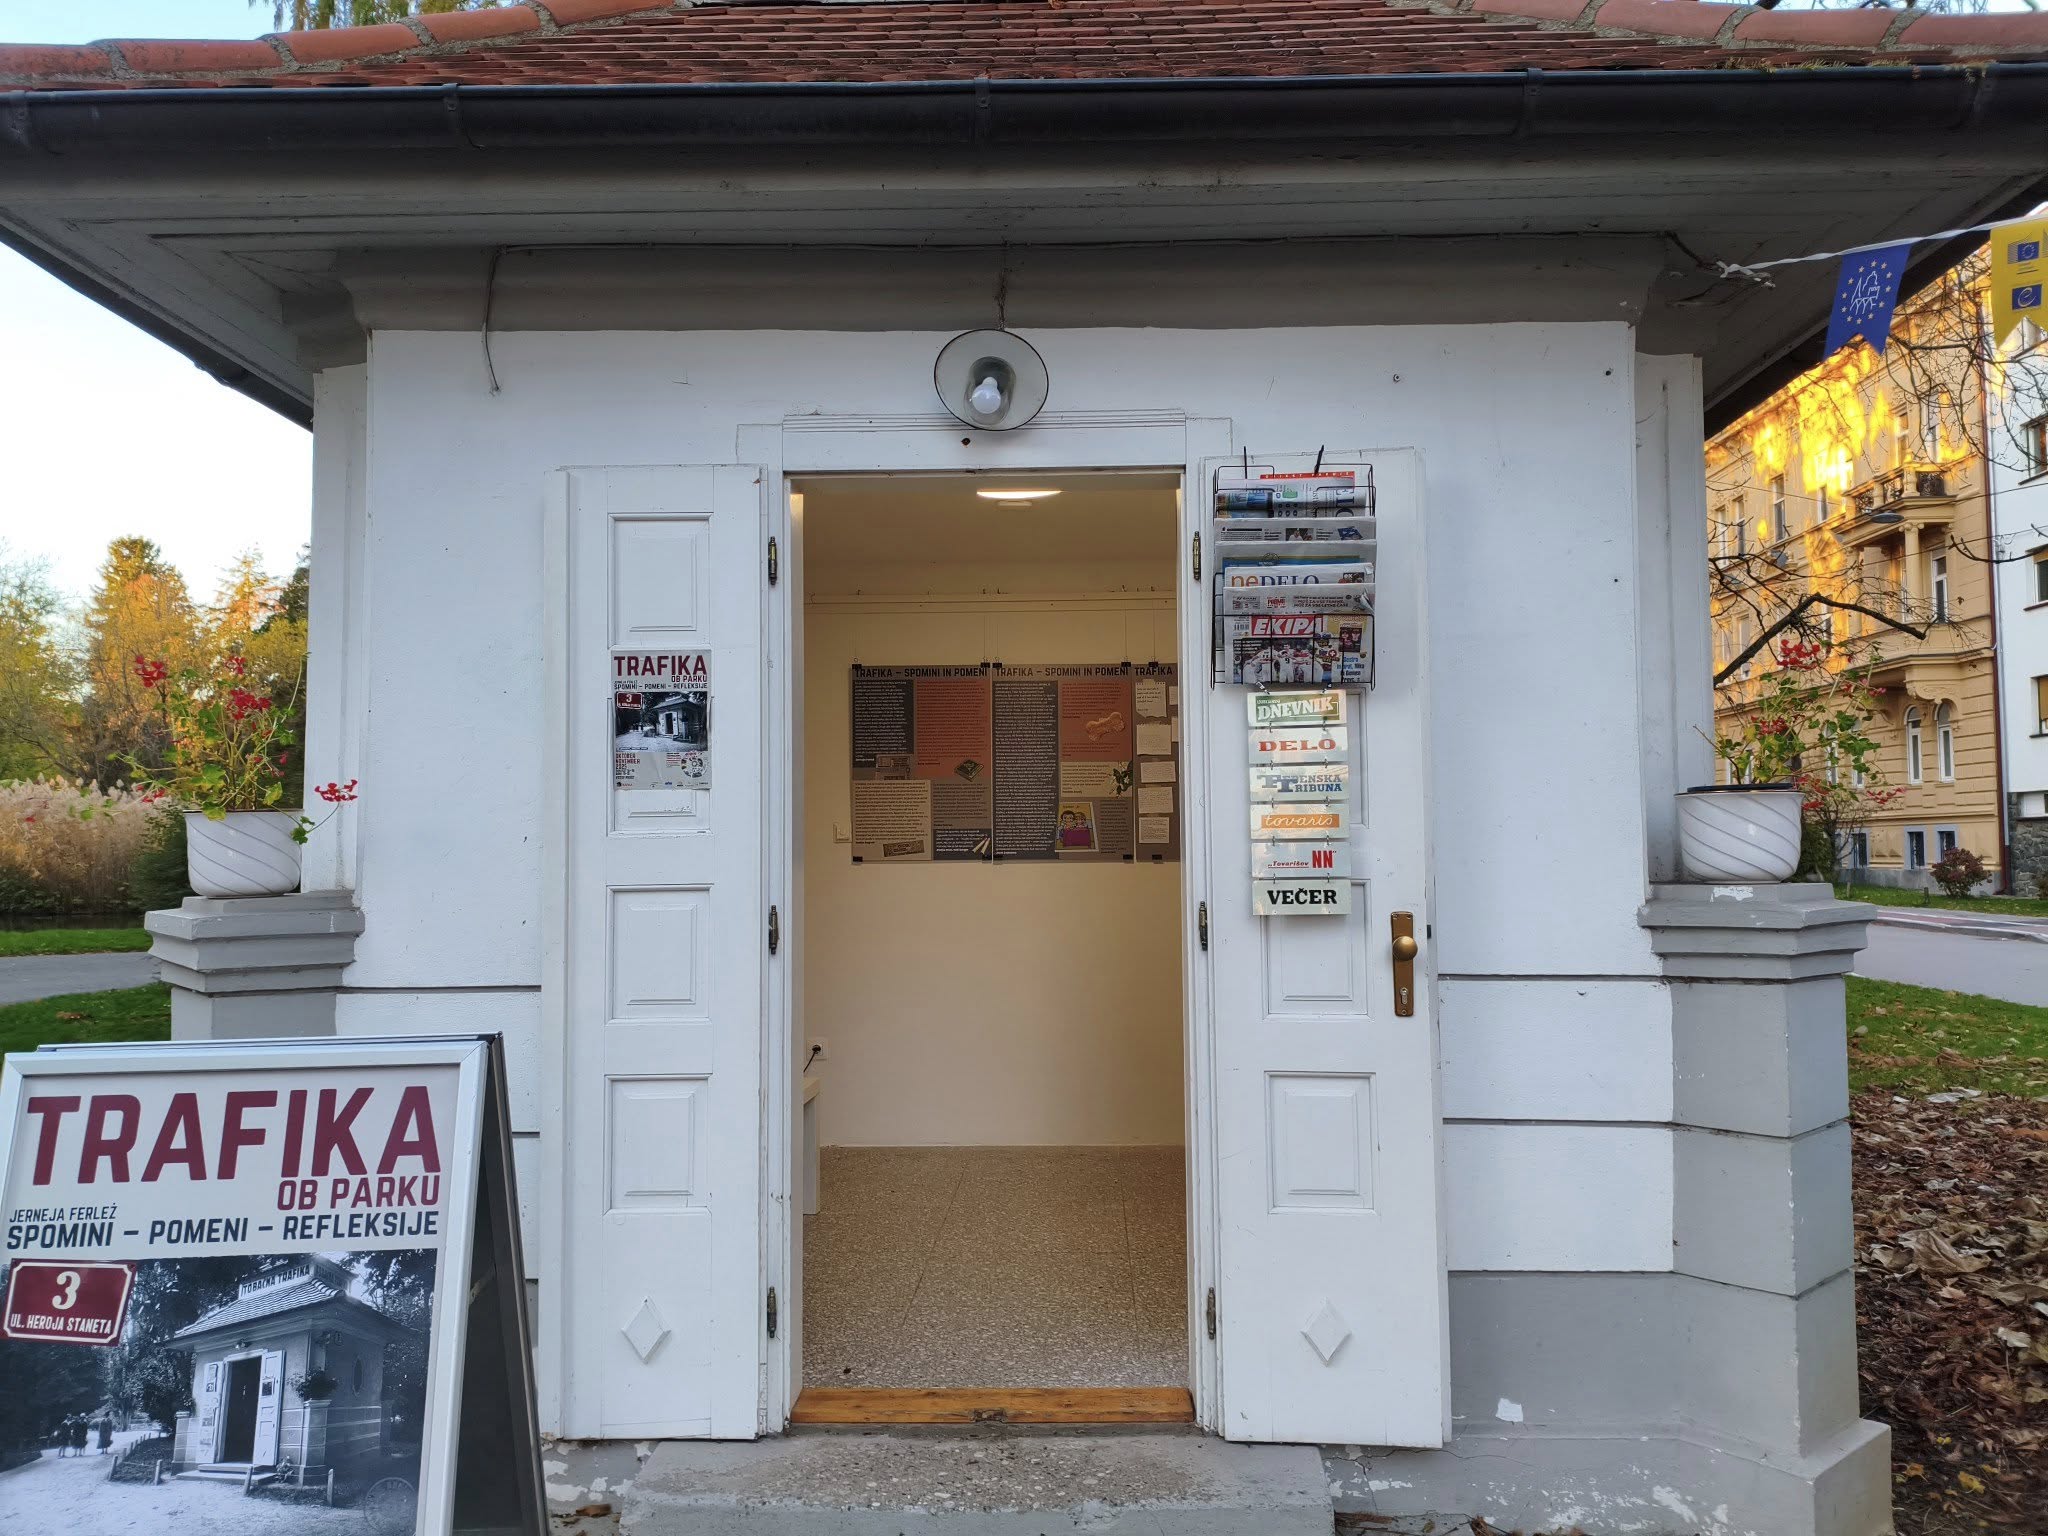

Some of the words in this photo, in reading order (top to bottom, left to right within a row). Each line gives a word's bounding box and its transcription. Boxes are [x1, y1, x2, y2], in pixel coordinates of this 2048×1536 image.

[1254, 617, 1323, 635] EKIPA
[614, 655, 707, 676] TRAFIKA
[855, 667, 893, 677] TRAFIKA
[904, 667, 940, 677] SPOMINI
[943, 667, 952, 676] IN
[954, 667, 988, 676] POMENI
[995, 667, 1033, 677] TRAFIKA
[1045, 667, 1081, 676] SPOMINI
[1084, 667, 1093, 676] IN
[1095, 666, 1129, 676] POMENI
[1134, 666, 1173, 676] TRAFIKA
[1257, 697, 1334, 720] DNEVNIK
[1258, 739, 1336, 751] DELO
[1267, 888, 1337, 904] VEČER
[27, 1086, 441, 1186] TRAFIKA
[277, 1180, 318, 1210] OB
[330, 1175, 440, 1209] PARKU
[9, 1208, 64, 1223] JERNEJA
[6, 1222, 114, 1249] SPOMINI
[149, 1218, 248, 1245] POMENI
[283, 1211, 439, 1240] REFLEKSIJE
[52, 1271, 81, 1310] 3
[10, 1314, 25, 1329] UL.
[27, 1315, 64, 1331] HEROJA
[67, 1317, 112, 1334] STANETA
